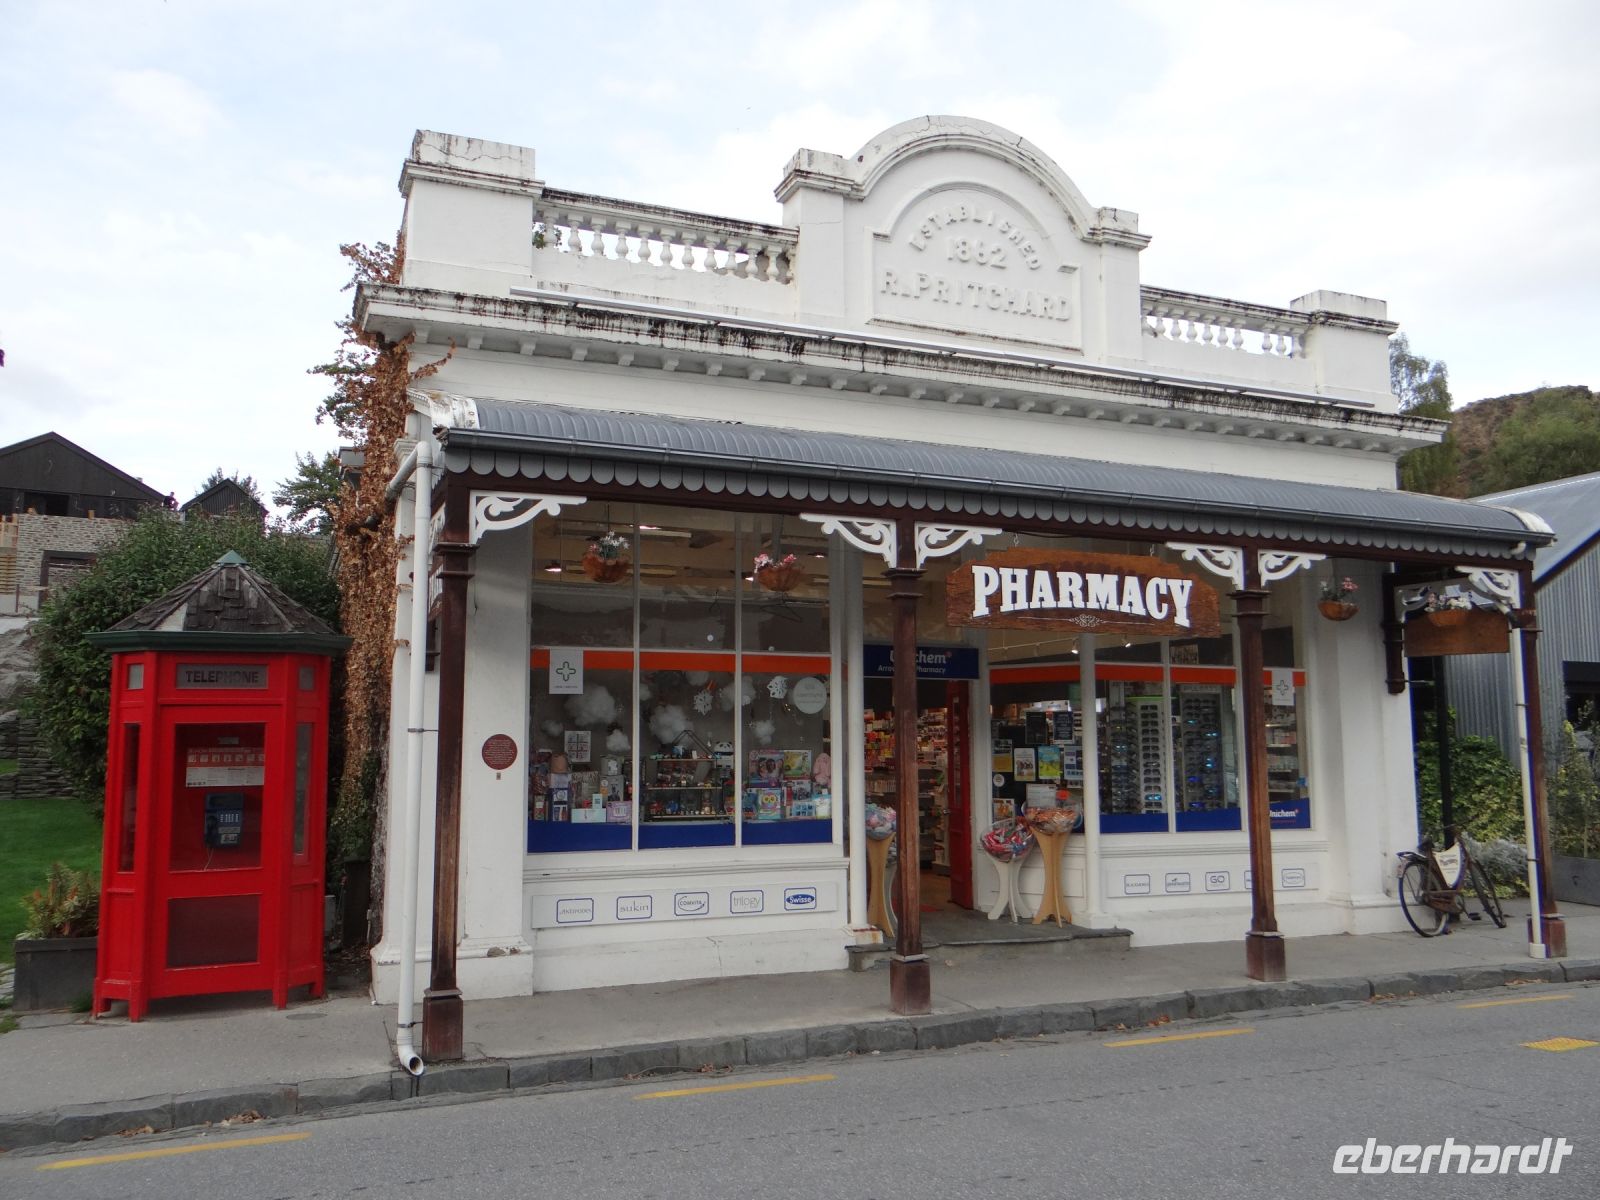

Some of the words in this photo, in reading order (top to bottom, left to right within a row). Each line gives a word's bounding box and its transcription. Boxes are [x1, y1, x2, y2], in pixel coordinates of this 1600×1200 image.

[946, 236, 1008, 269] 1862
[971, 565, 1193, 628] PHARMACY
[185, 670, 260, 684] TELEPHONE
[1210, 875, 1226, 884] GO
[733, 895, 761, 908] trilogy
[789, 896, 812, 904] Swisse
[620, 901, 649, 913] sukin
